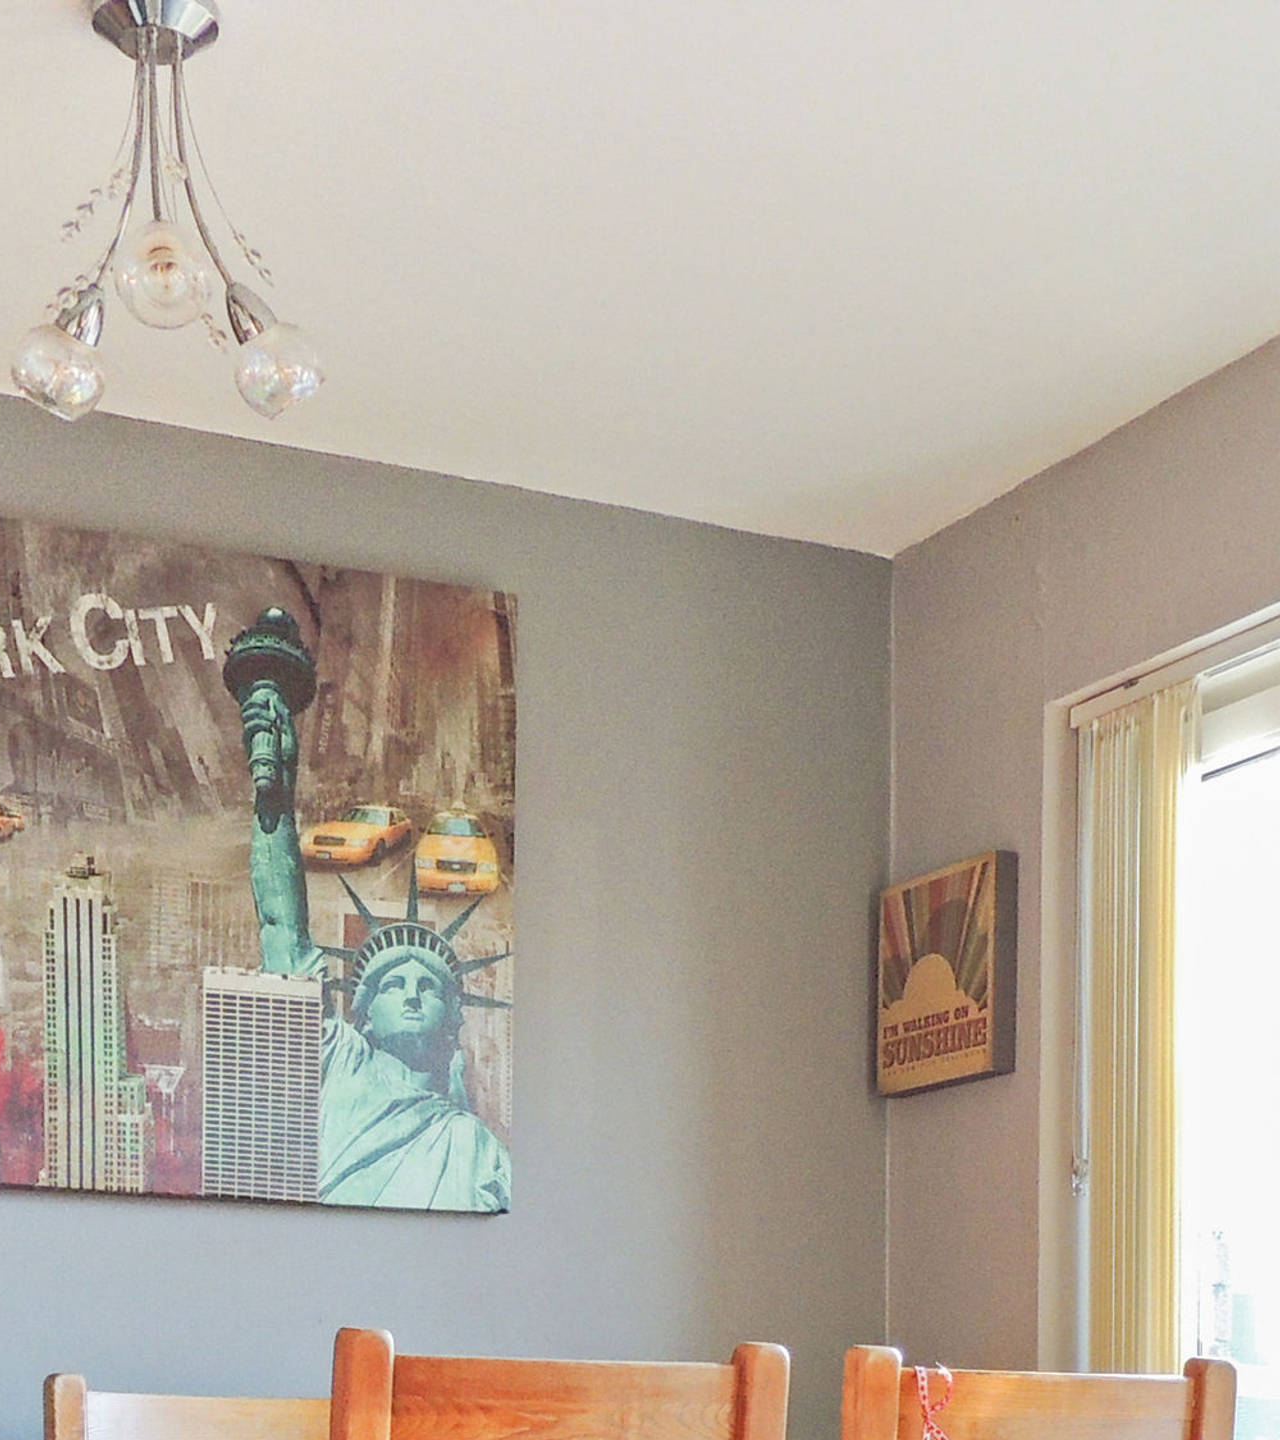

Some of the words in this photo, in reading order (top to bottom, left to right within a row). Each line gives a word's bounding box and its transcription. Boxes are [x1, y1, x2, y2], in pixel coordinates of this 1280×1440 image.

[69, 593, 217, 670] CITY
[882, 1017, 987, 1069] SUNSHINE
[902, 1010, 949, 1033] WALKING
[954, 1005, 969, 1020] ON
